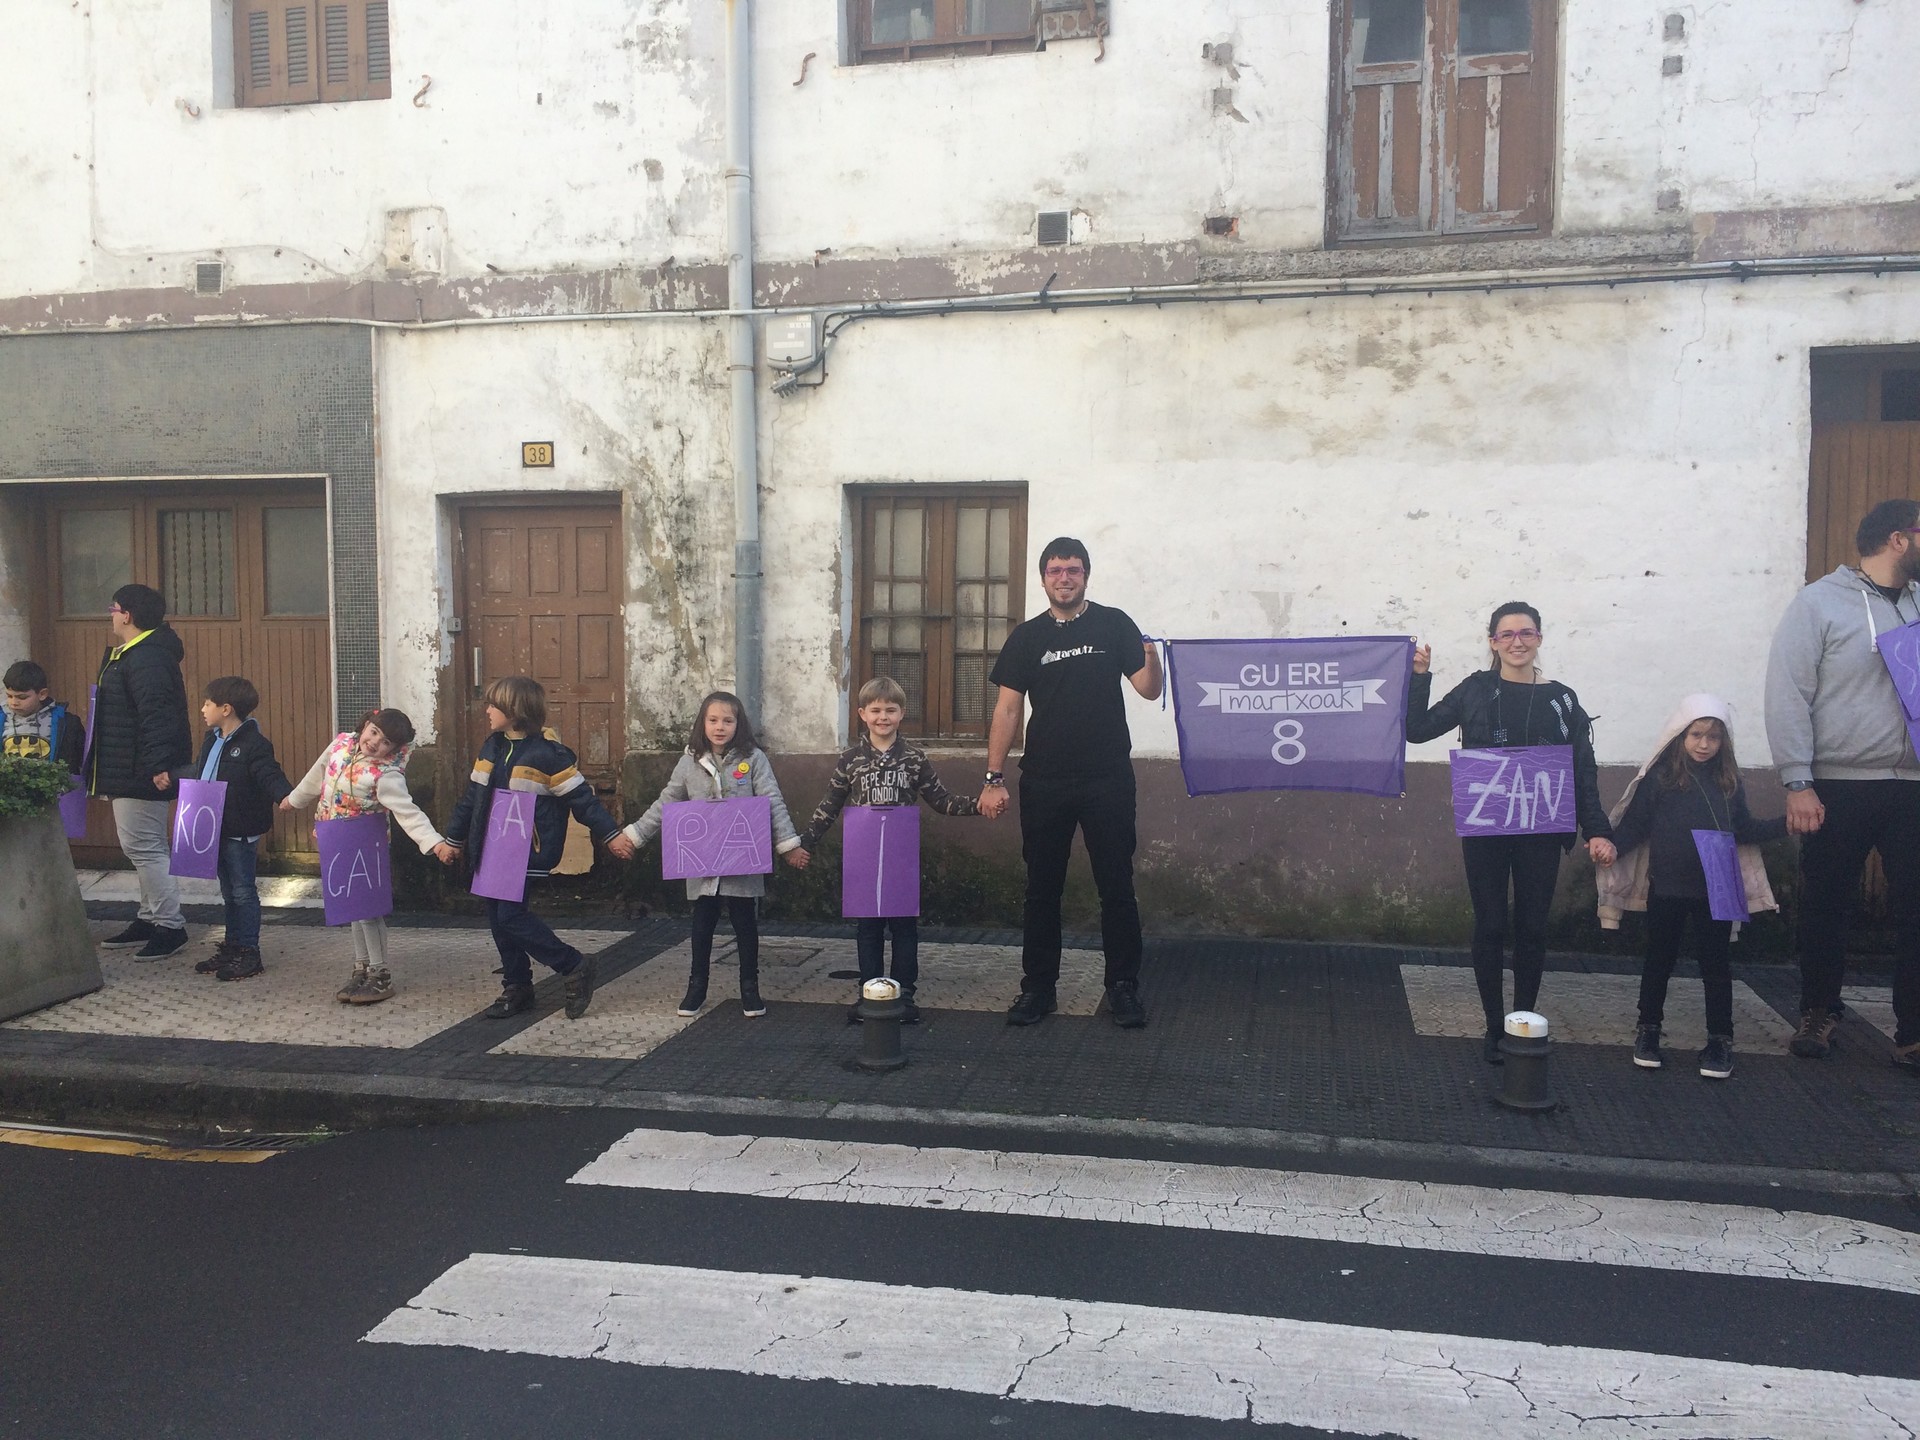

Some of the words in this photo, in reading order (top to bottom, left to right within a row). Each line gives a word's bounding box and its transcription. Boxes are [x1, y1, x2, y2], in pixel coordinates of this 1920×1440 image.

[529, 446, 546, 463] 38
[1240, 663, 1280, 687] GU
[1287, 661, 1340, 686] ERE
[1271, 719, 1306, 765] 8
[860, 771, 881, 792] PEPE
[881, 770, 908, 789] JEANS
[1456, 749, 1566, 831] ZAN
[175, 801, 217, 854] KO
[676, 809, 762, 873] RA
